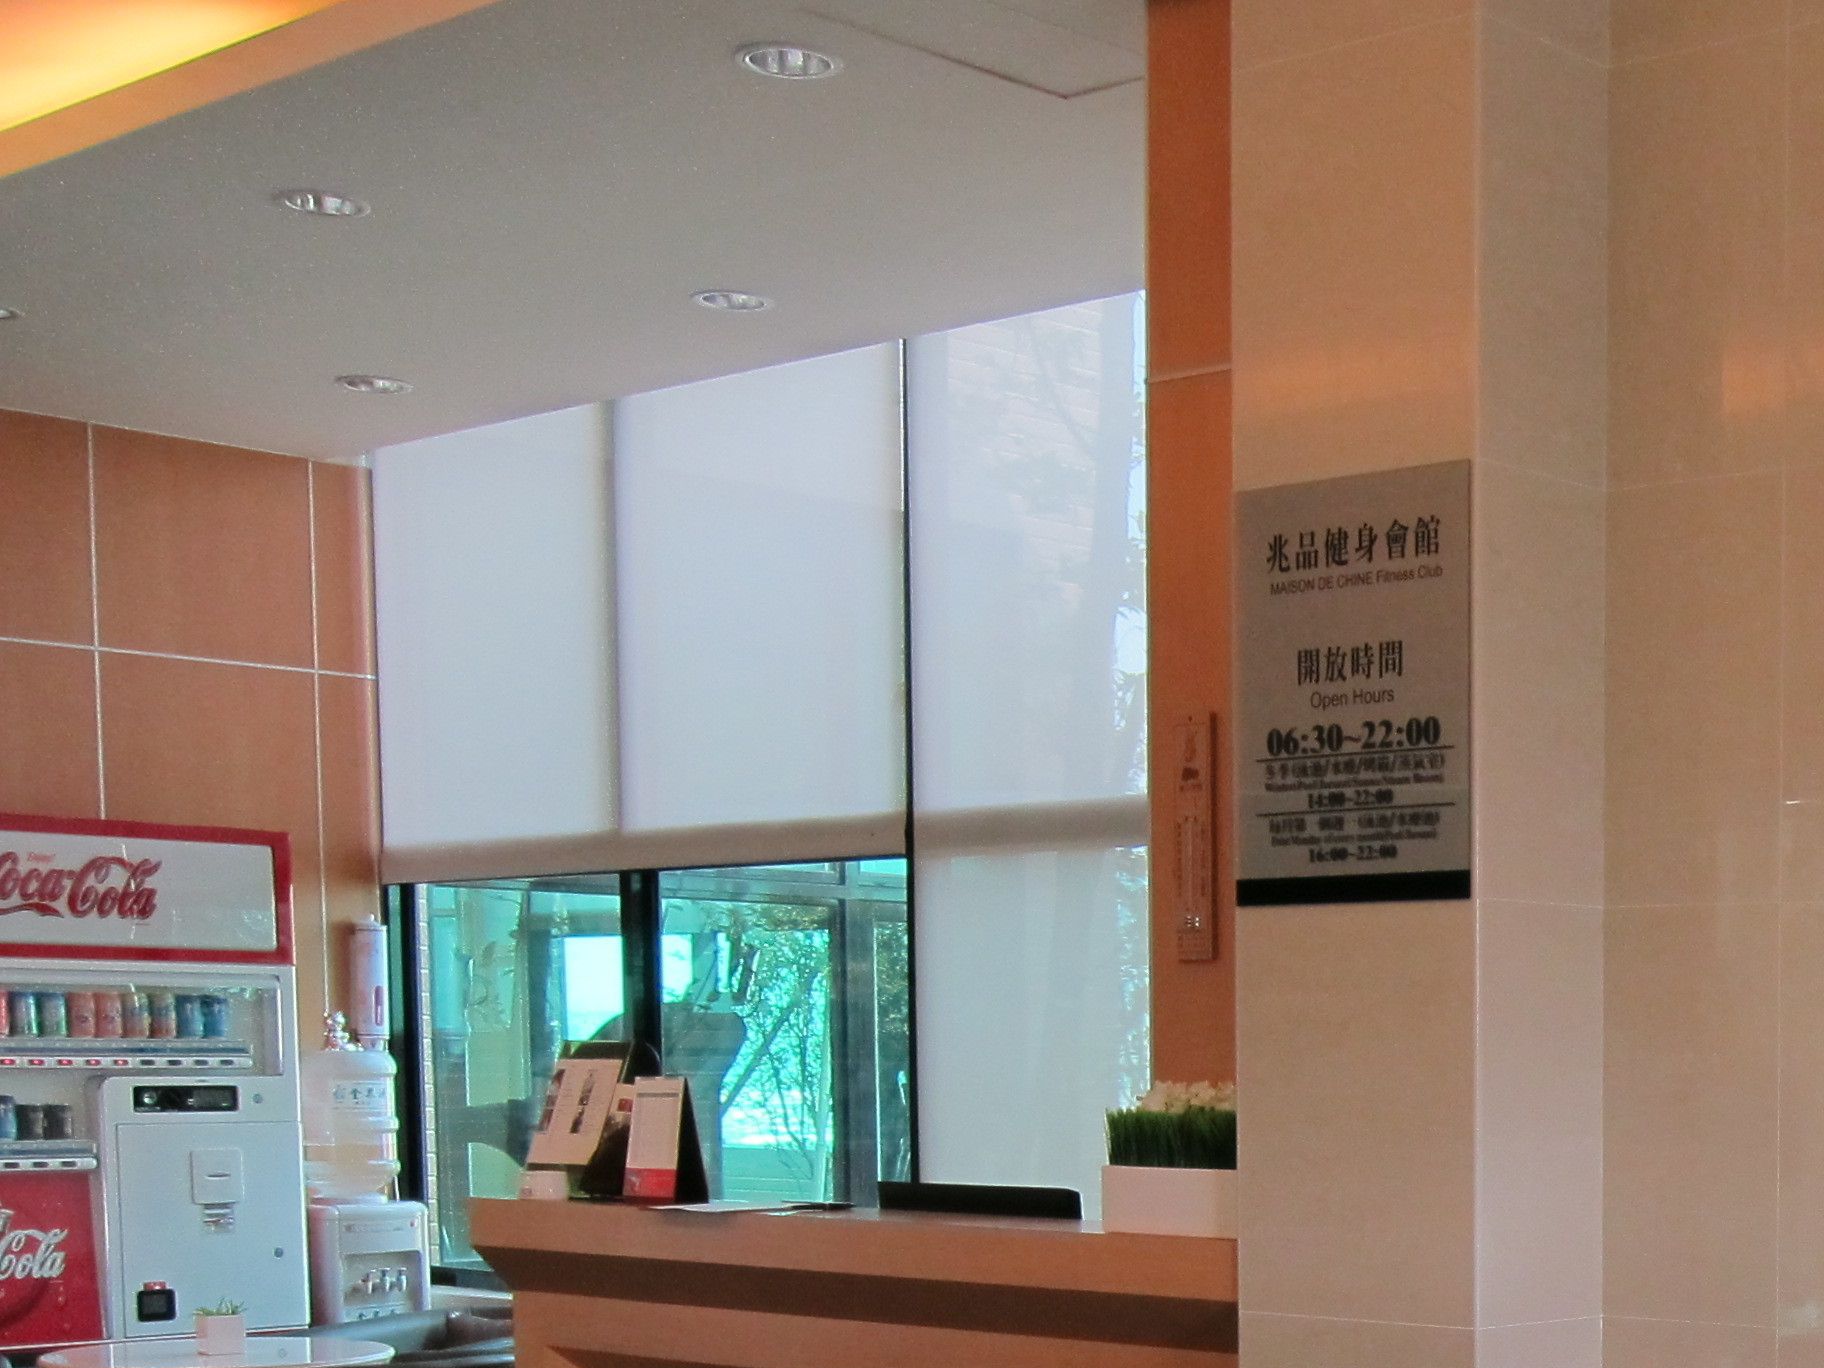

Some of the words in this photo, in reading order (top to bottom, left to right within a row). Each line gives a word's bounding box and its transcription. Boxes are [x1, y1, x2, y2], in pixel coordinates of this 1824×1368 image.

[1266, 514, 1441, 573] 兆品健身會館
[1270, 579, 1315, 596] MAISON
[1318, 576, 1335, 591] DE
[1337, 571, 1373, 588] CHINE
[1376, 568, 1414, 584] Fitness
[1417, 564, 1443, 579] Club
[1297, 639, 1403, 686] 開放時間
[1310, 691, 1350, 711] Open
[1353, 688, 1395, 704] Hours
[1266, 715, 1441, 757] 06:30~22:00
